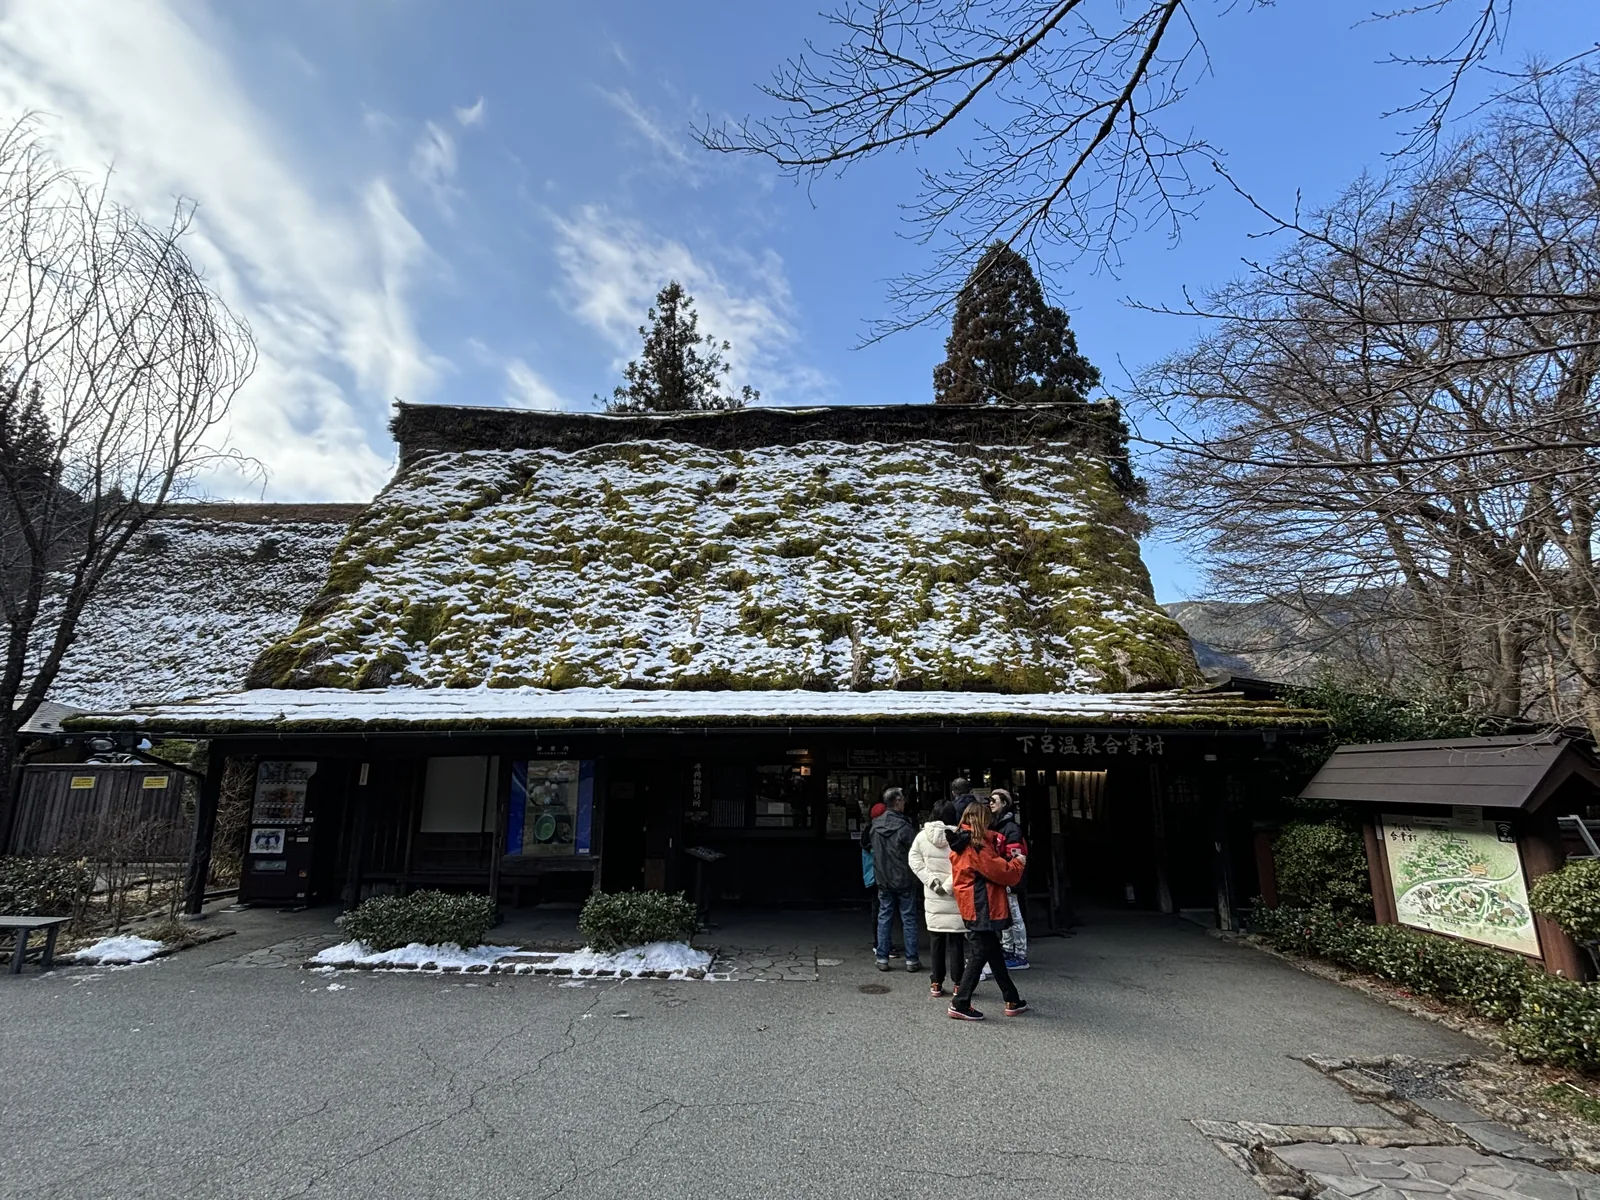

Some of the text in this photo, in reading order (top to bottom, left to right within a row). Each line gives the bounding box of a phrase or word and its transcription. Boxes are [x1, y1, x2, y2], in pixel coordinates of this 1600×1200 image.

[1016, 733, 1165, 756] 下呂温泉合掌村
